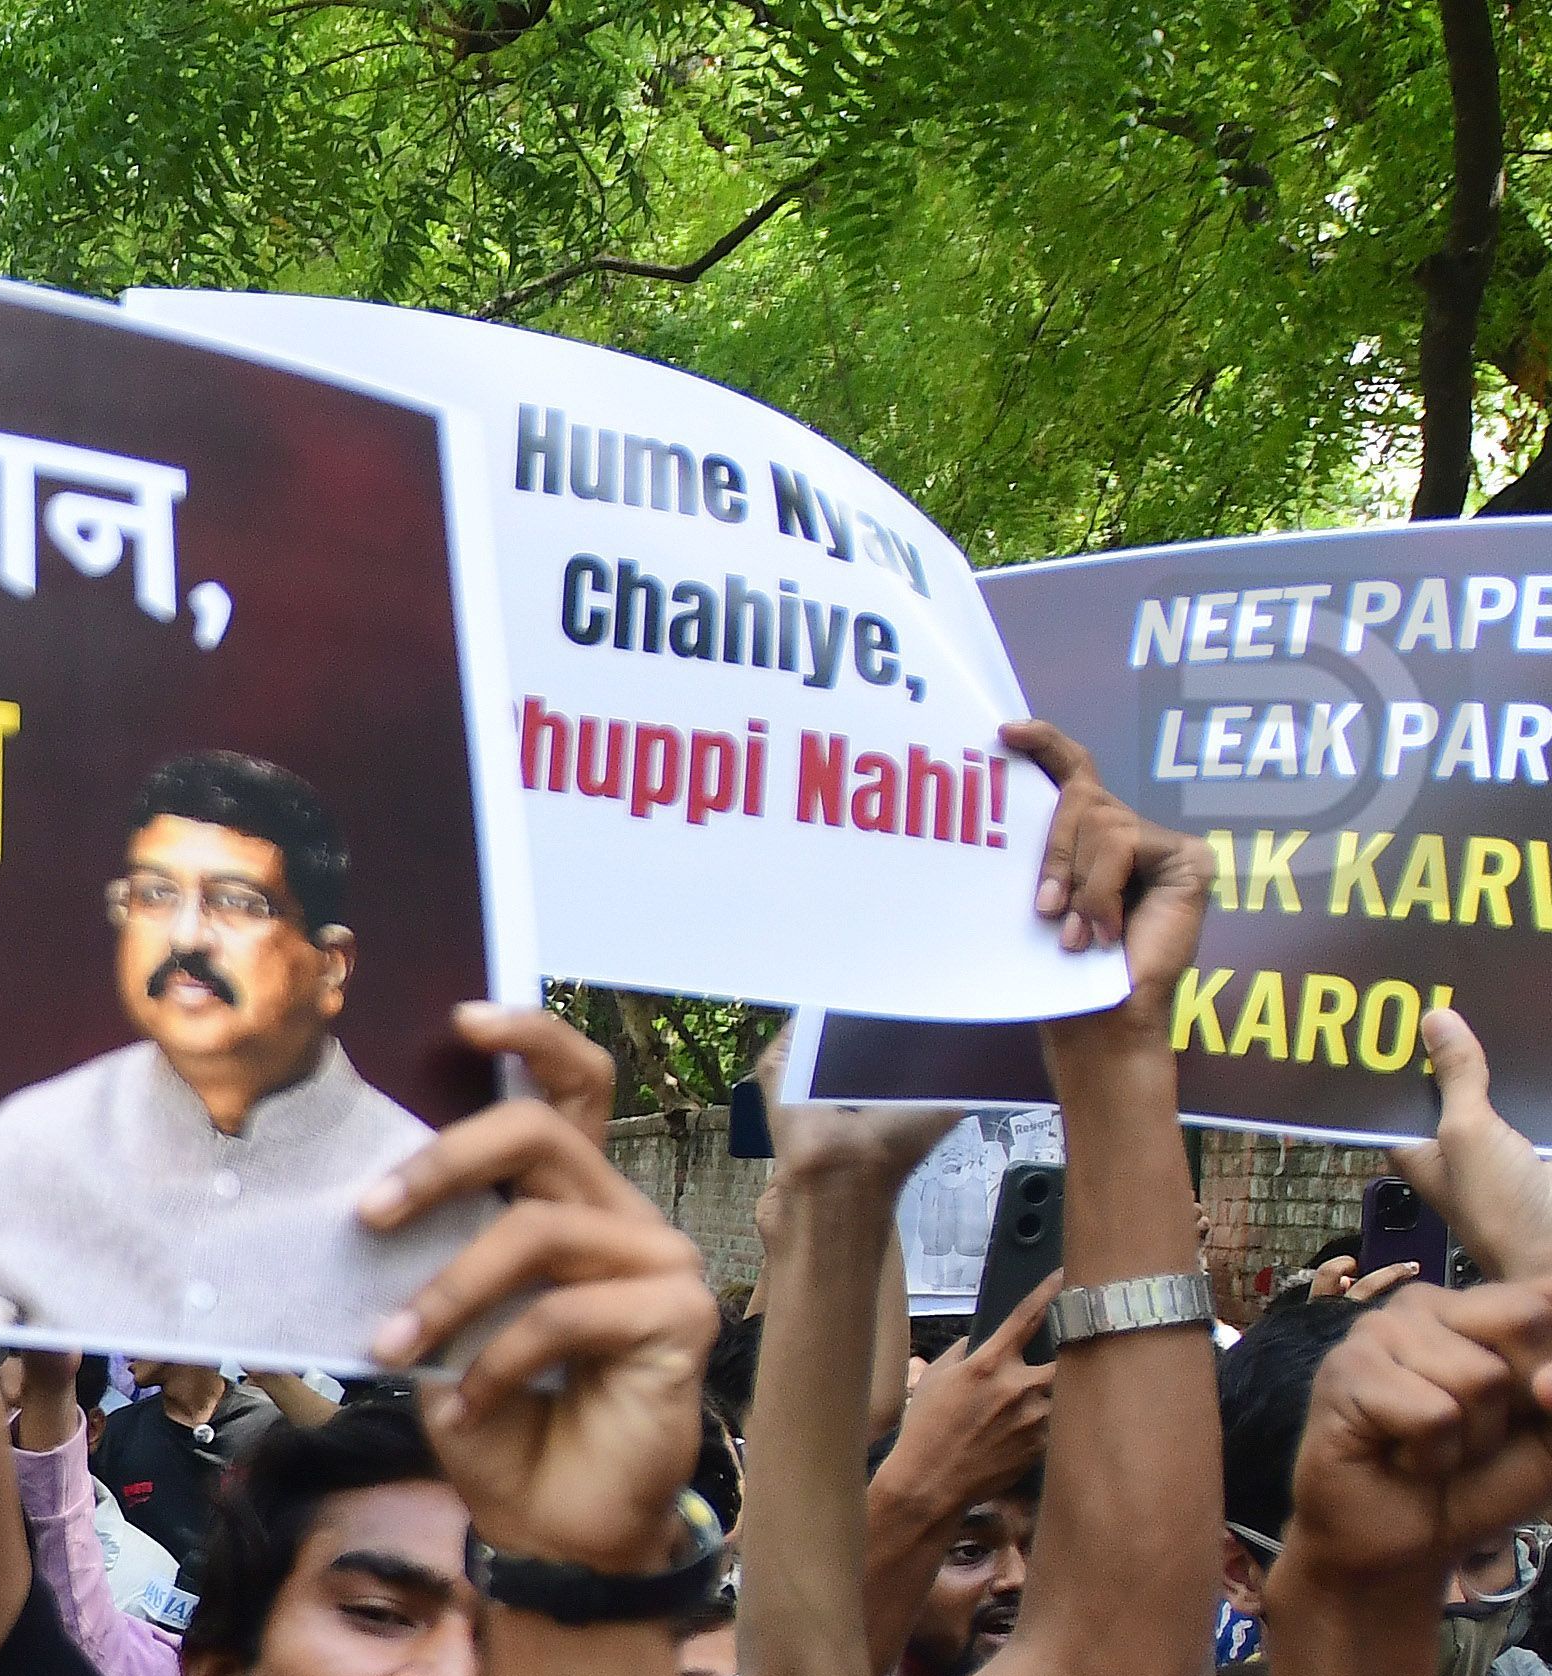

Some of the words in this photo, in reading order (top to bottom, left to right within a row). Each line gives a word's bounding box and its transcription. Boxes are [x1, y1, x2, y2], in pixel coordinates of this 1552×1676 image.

[515, 402, 749, 523] Hume
[769, 460, 931, 599] Nyay
[562, 552, 928, 704] Chahiye,
[1132, 583, 1332, 667] NEET
[520, 694, 769, 826] huppi
[797, 728, 1009, 849] Nahi!
[1153, 702, 1364, 780] LEAK
[1204, 829, 1311, 912] AK
[1170, 967, 1455, 1075] KARO!
